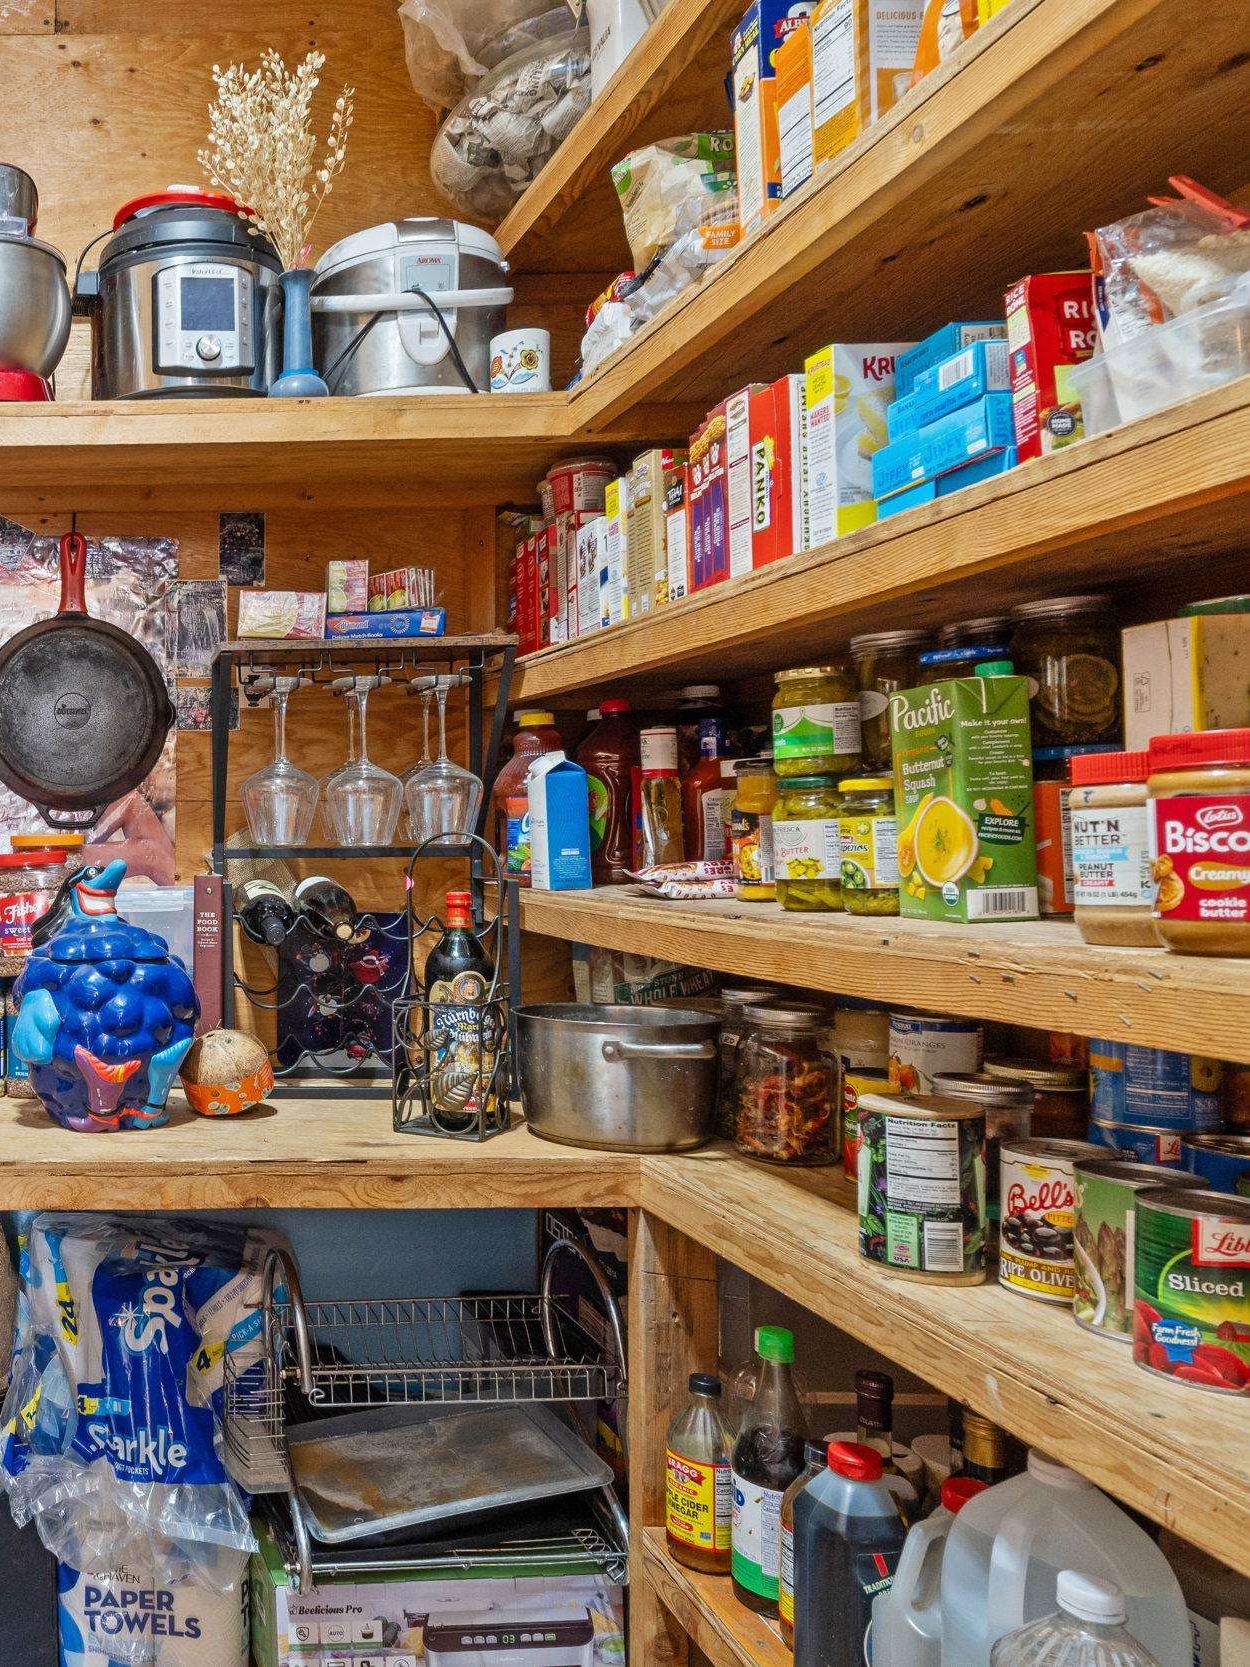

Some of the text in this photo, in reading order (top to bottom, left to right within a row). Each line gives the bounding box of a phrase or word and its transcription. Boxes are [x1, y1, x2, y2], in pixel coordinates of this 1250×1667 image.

[876, 11, 916, 20] DELICIOUS
[706, 230, 736, 240] FAMILY
[711, 237, 730, 246] SIZE
[1063, 301, 1095, 319] RI
[1069, 330, 1098, 349] RO
[878, 461, 910, 488] JIFFY
[754, 448, 766, 525] PANKO
[890, 688, 955, 732] Pacific
[961, 717, 1027, 728] Make it your own!
[902, 757, 944, 776] Butternut
[904, 779, 936, 795] Squash
[985, 816, 1020, 828] EXPLORE
[1204, 810, 1238, 823] Lotus
[1074, 820, 1119, 832] NUT'N
[1075, 834, 1121, 845] BETTER
[1165, 821, 1250, 853] Bisco
[781, 847, 809, 857] BUTTER
[1079, 863, 1114, 871] PEANUT
[1080, 870, 1113, 878] BUTTER
[1191, 867, 1250, 884] Creamy
[1200, 897, 1247, 907] cookie
[3, 902, 43, 924] Fisher
[1200, 906, 1247, 918] butter
[680, 970, 715, 997] WHEAT
[437, 1007, 496, 1028] Nürnbge
[906, 1038, 946, 1049] ORANGES
[888, 1118, 956, 1129] Nutrition Facts
[1007, 1181, 1074, 1216] Bell's
[1047, 1213, 1073, 1224] PITTE
[1000, 1257, 1074, 1288] RIPE OLIVE
[1168, 1273, 1245, 1298] Sliced
[58, 1301, 79, 1336] 24
[1152, 1323, 1201, 1337] Farm Fresh
[1155, 1333, 1198, 1347] Goodness!
[196, 1349, 211, 1371] 4
[87, 1422, 187, 1475] Sarkle
[668, 1458, 700, 1478] BRAGG
[668, 1500, 700, 1520] INEGAR
[681, 1498, 709, 1513] CIDER
[863, 1575, 896, 1595] TRADITIO
[84, 1585, 175, 1612] PAPER
[298, 1604, 363, 1615] Beelicious Pro
[84, 1610, 202, 1640] TOWELS
[502, 1635, 517, 1643] 03
